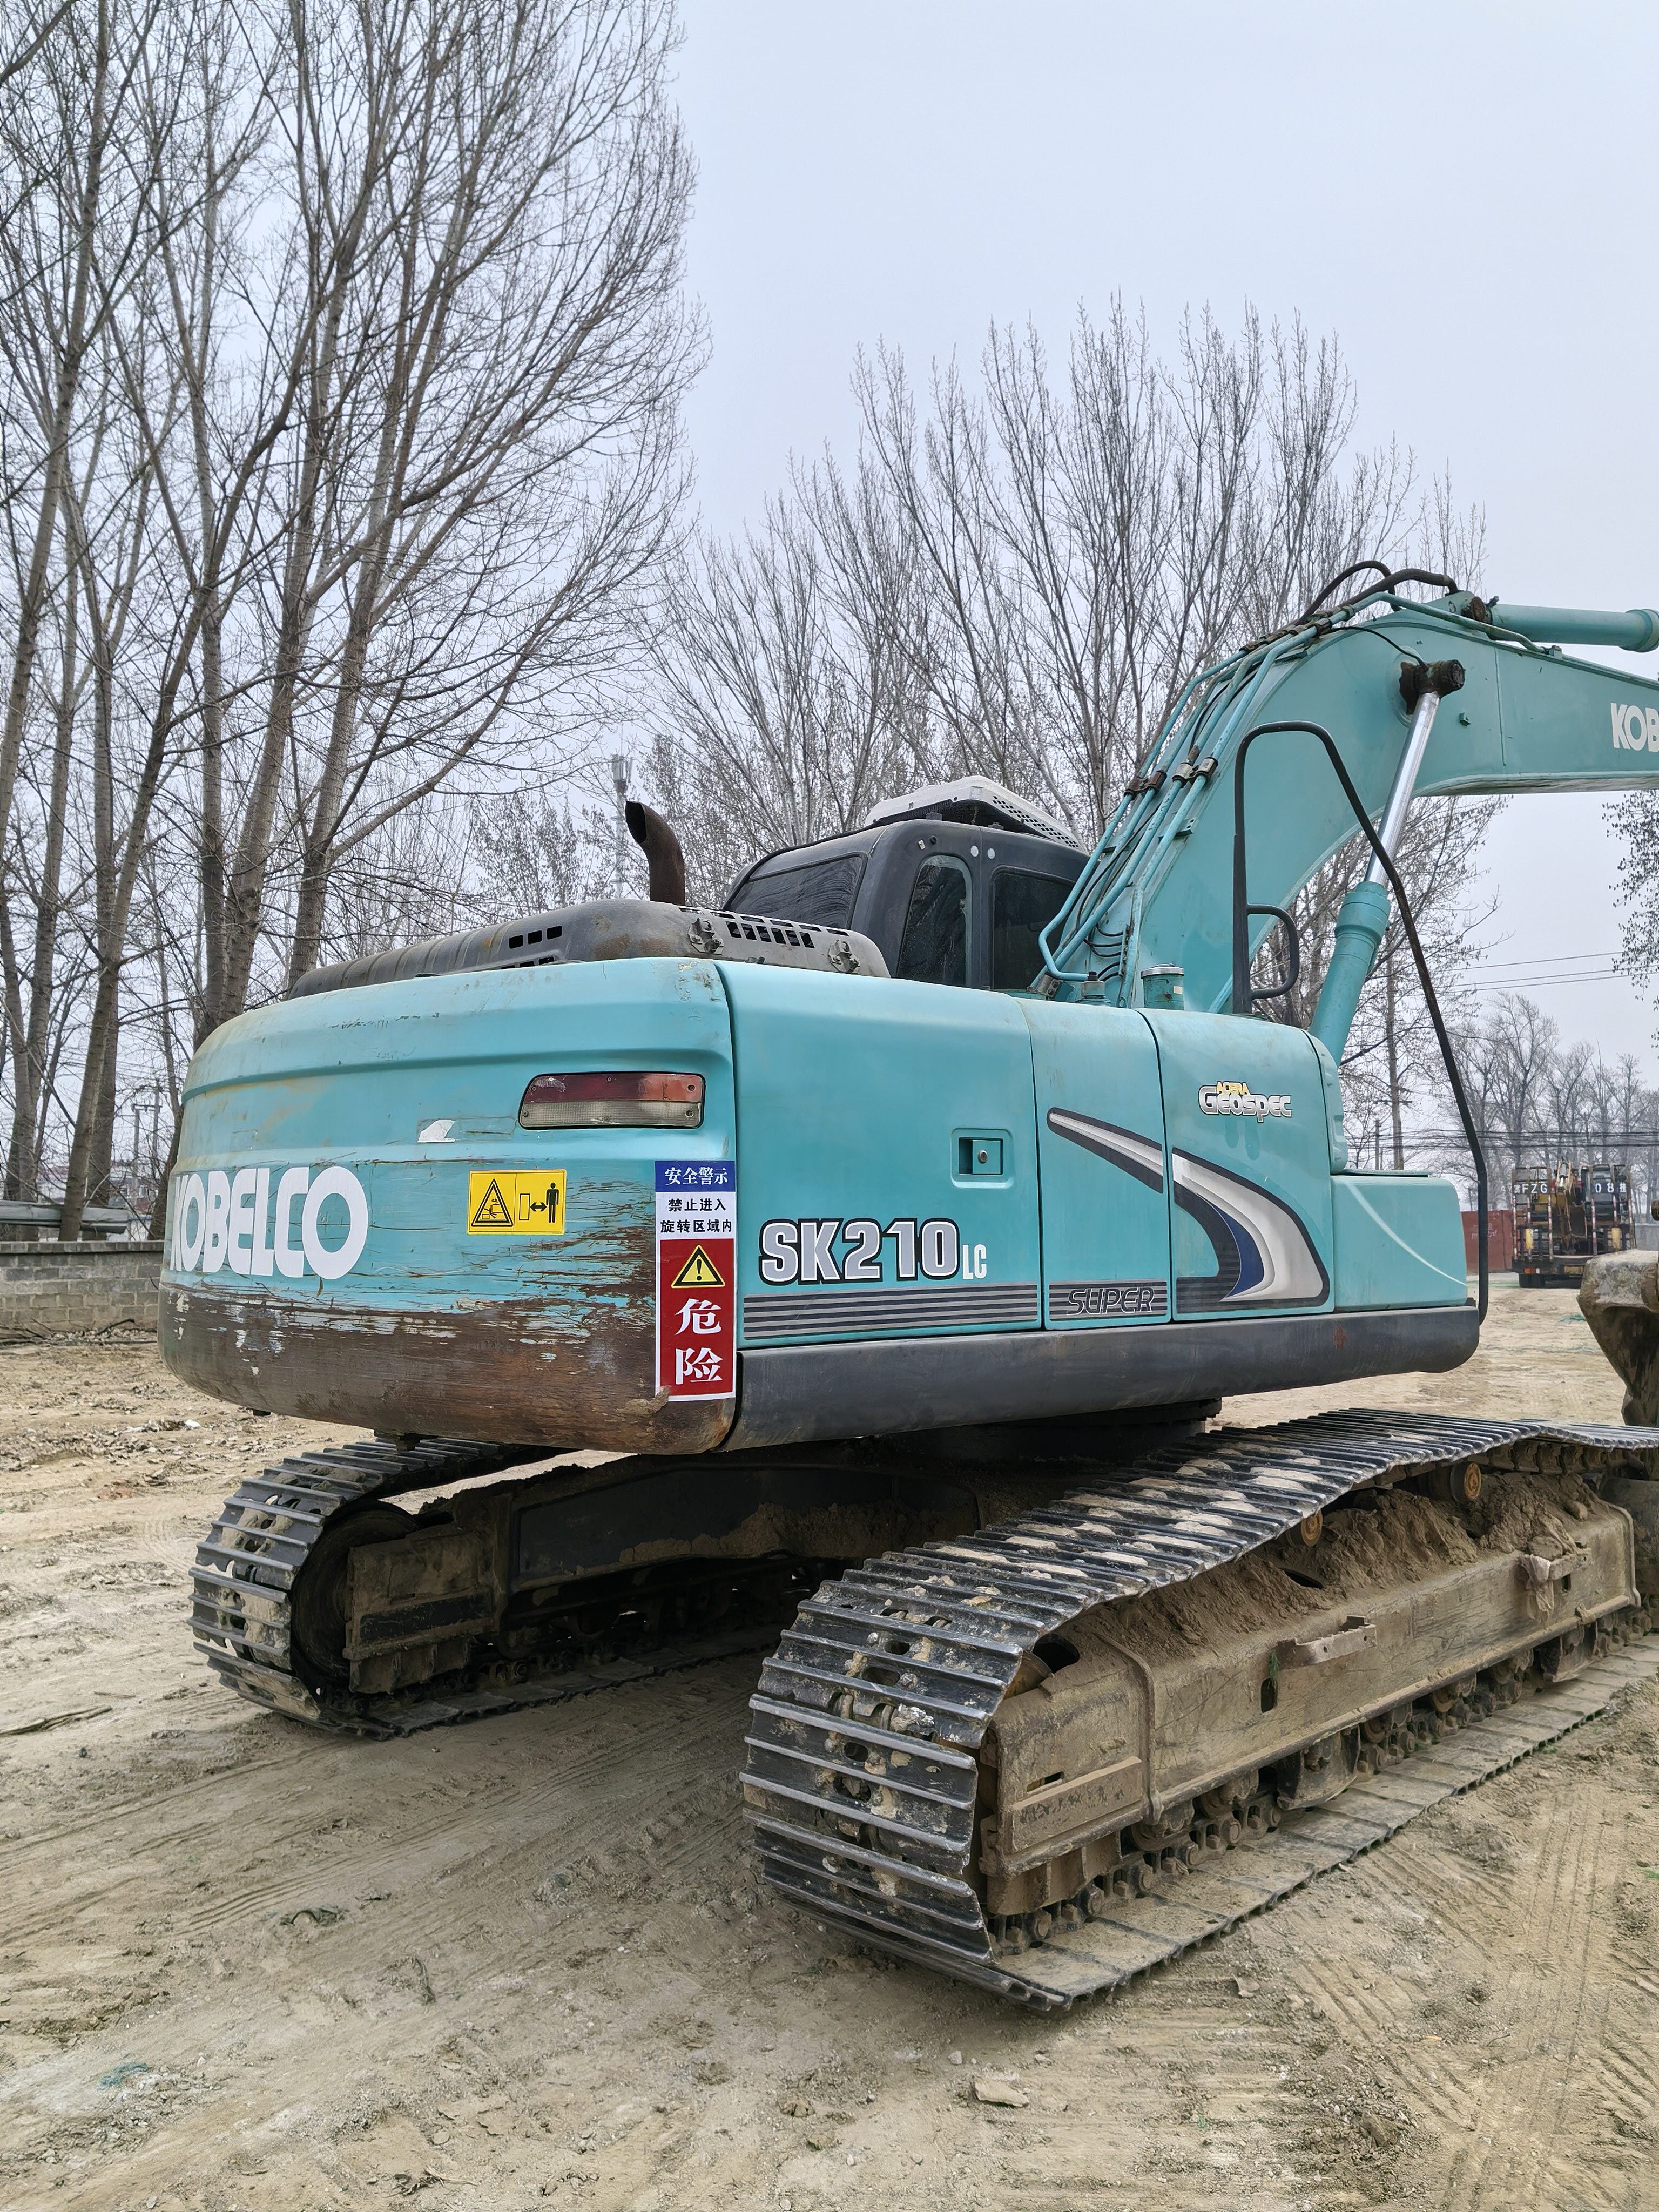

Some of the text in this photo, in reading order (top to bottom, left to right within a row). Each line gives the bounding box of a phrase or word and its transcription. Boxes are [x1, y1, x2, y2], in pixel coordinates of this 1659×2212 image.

[1610, 703, 1659, 752] KOB
[665, 1166, 728, 1186] 安全警示
[669, 1198, 726, 1212] 禁止进入
[170, 1166, 368, 1280] KOBELCO
[660, 1218, 732, 1233] 旋转区域内
[1066, 1287, 1155, 1316] SUPER
[675, 1298, 723, 1385] 危险
